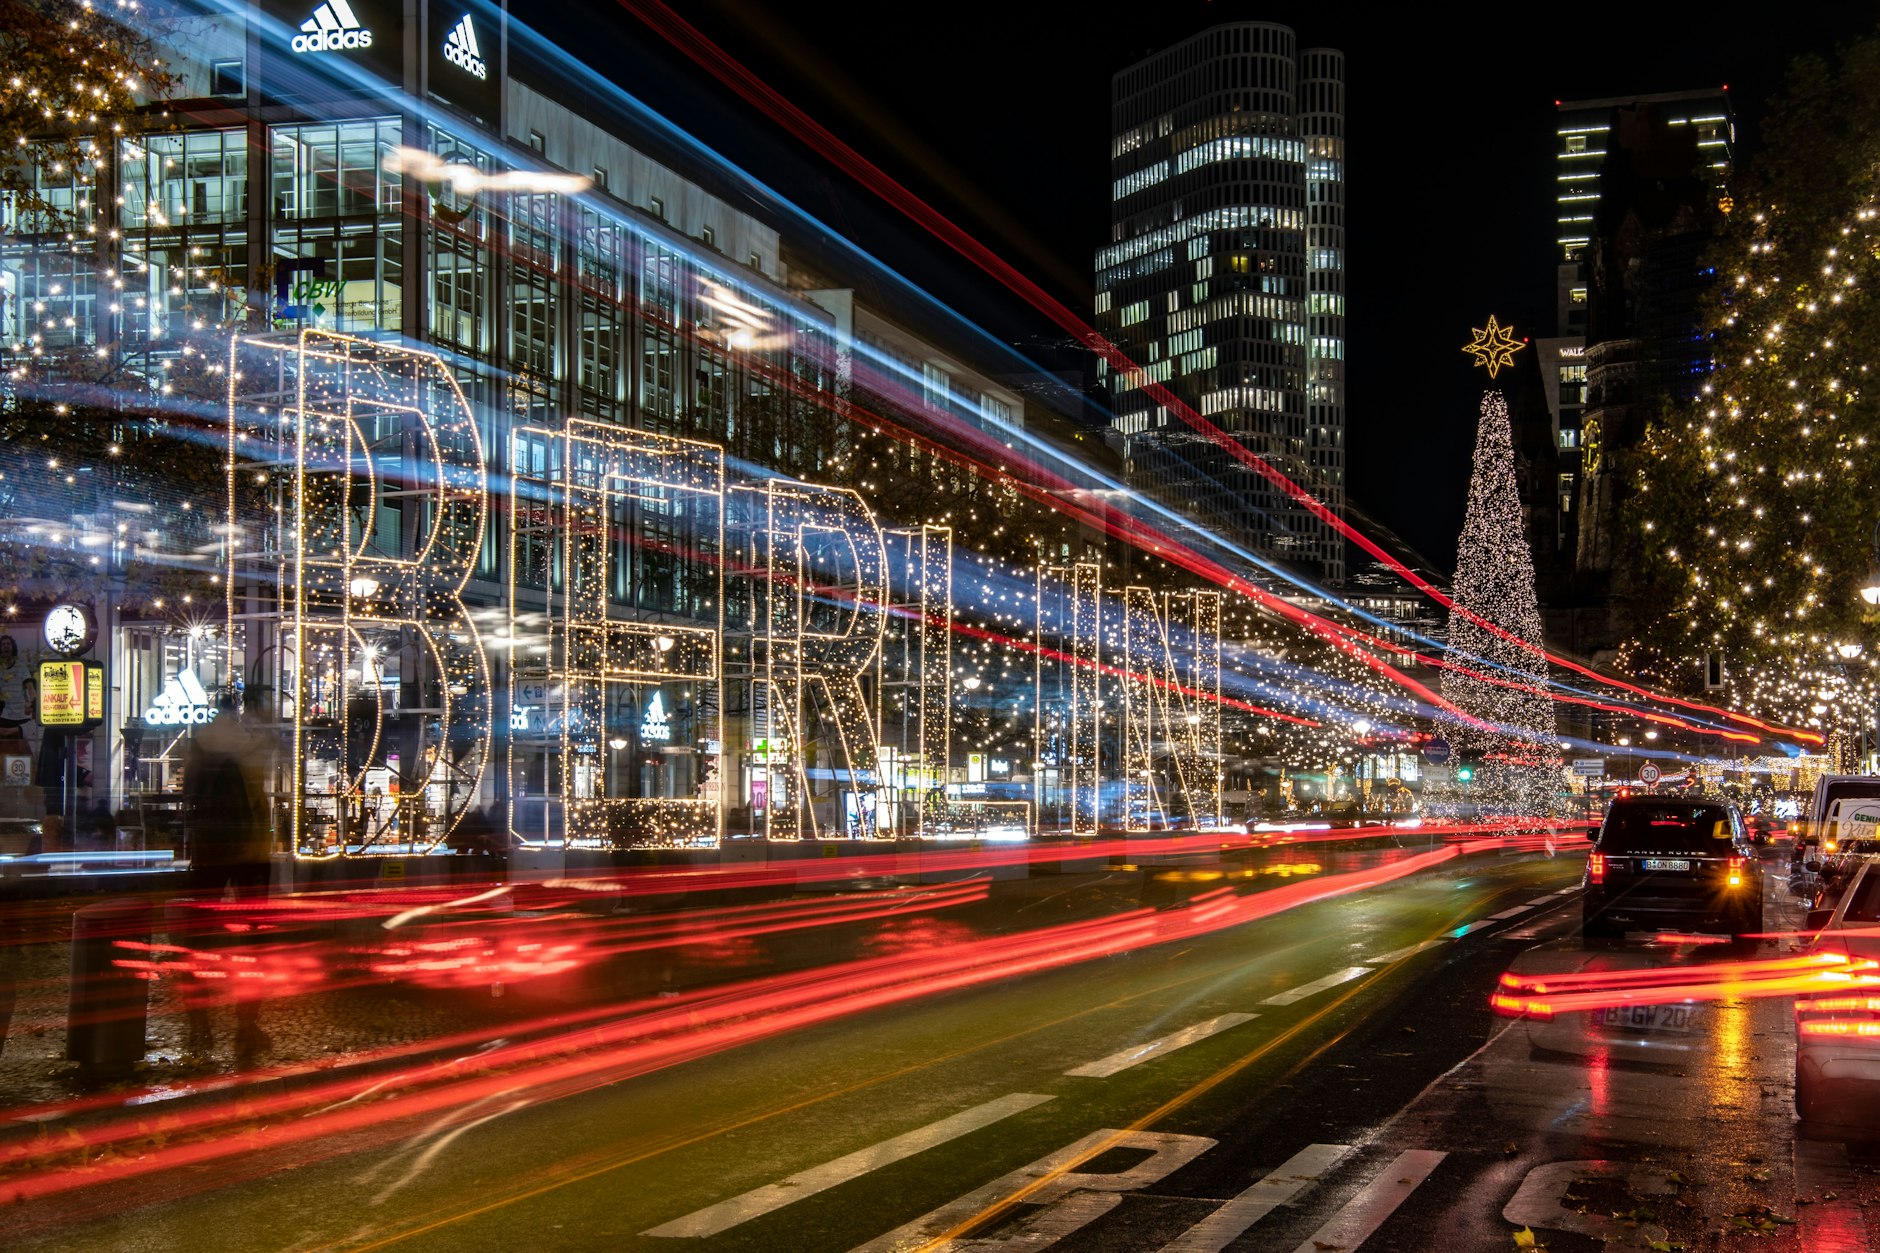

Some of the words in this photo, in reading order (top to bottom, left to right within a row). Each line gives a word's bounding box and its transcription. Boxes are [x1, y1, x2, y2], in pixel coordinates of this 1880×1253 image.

[291, 28, 373, 53] adidas
[444, 42, 486, 81] adidas
[293, 278, 348, 300] CBW
[230, 328, 1223, 860] BERLIN
[43, 693, 68, 703] ANKAUF
[145, 703, 219, 725] adidas
[641, 721, 670, 740] adidas
[1643, 769, 1656, 779] 30
[1646, 861, 1652, 869] B
[1605, 1006, 1618, 1024] B
[1631, 1005, 1658, 1025] GW
